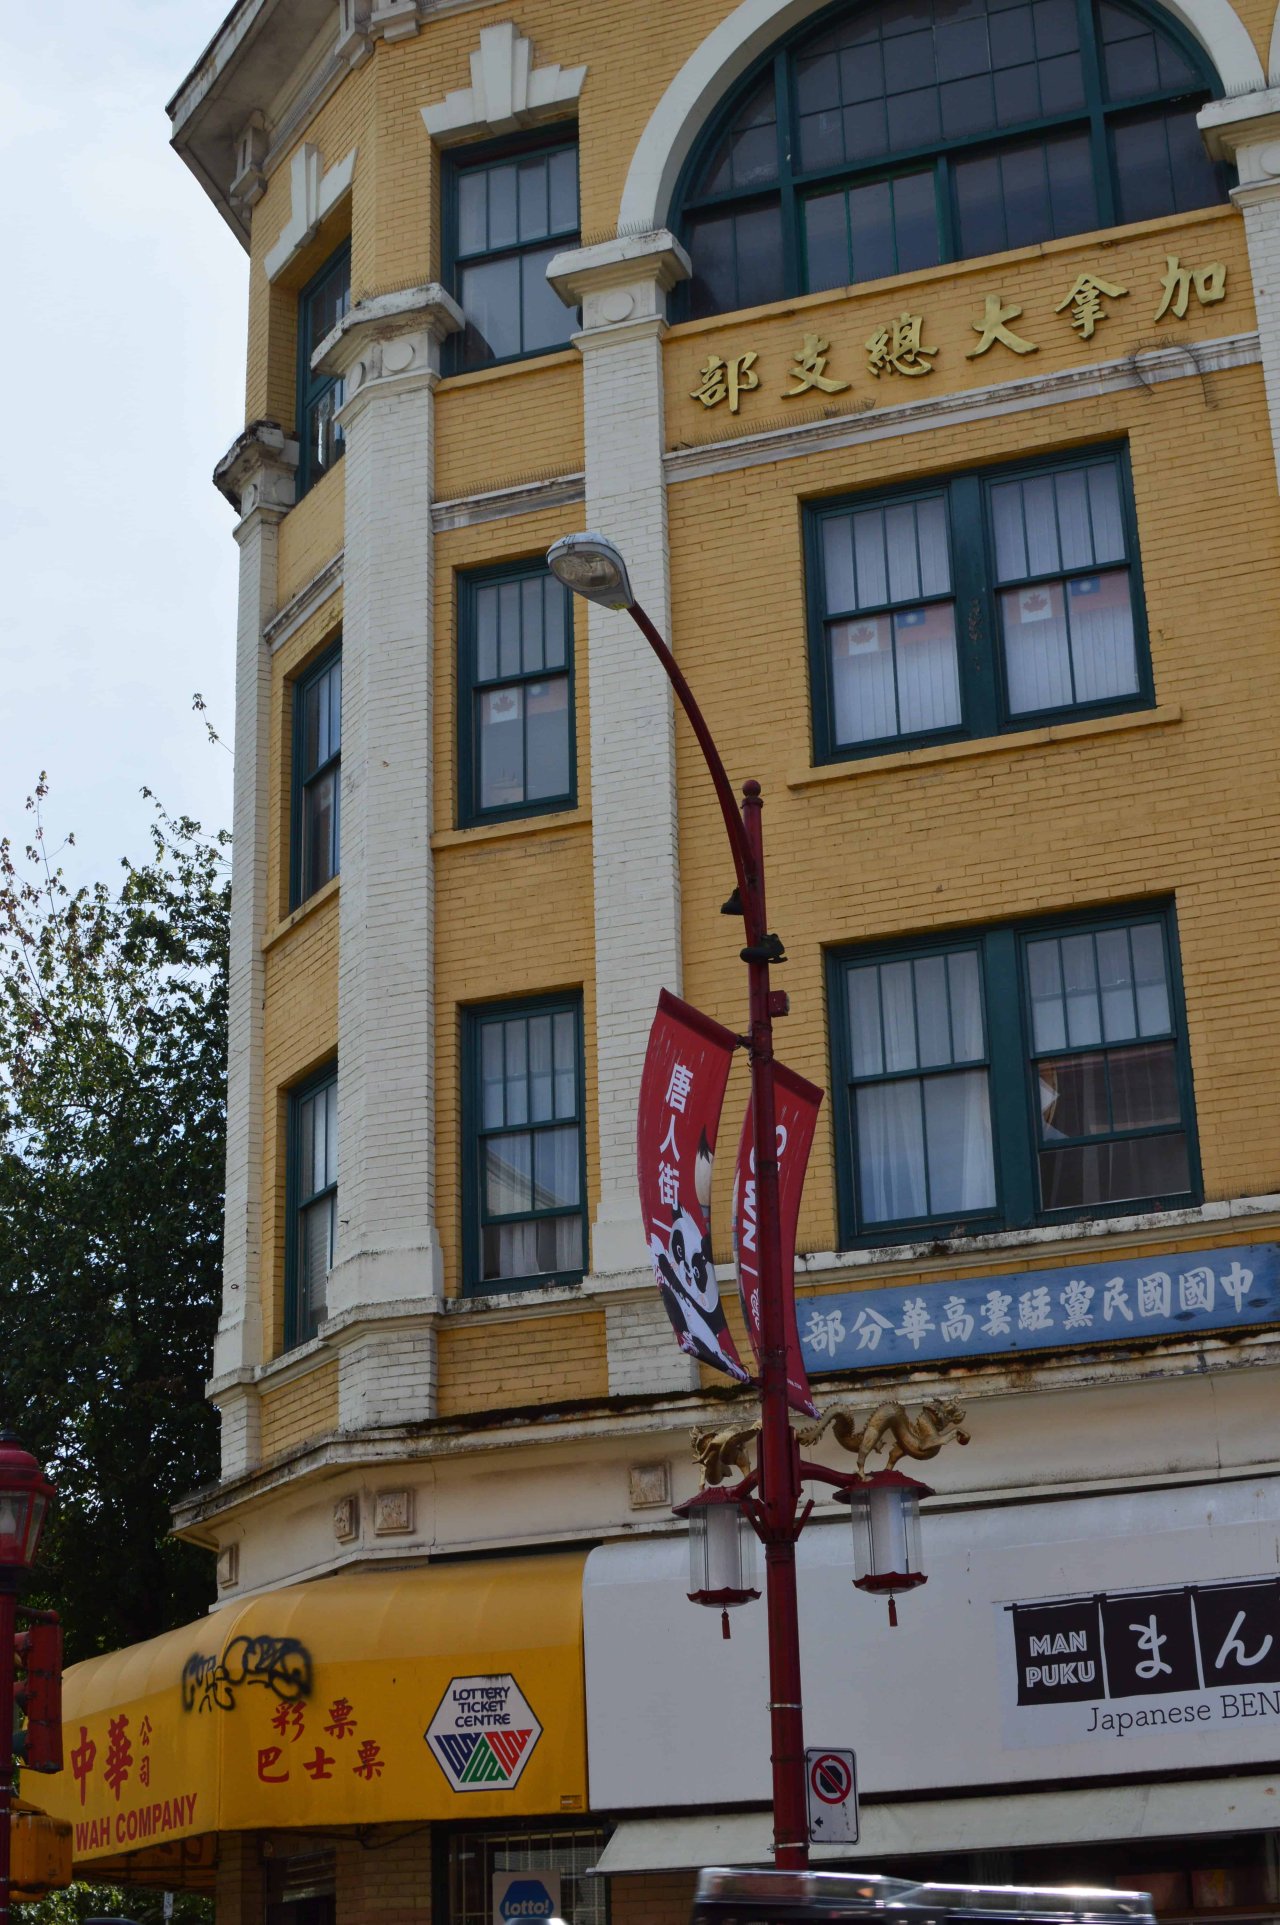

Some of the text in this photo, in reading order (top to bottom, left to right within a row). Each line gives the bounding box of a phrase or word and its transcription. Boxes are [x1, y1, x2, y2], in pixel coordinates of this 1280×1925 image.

[659, 1062, 694, 1211] 唐人街
[1029, 1630, 1088, 1657] MAN
[1025, 1660, 1096, 1688] PUKU
[452, 1686, 511, 1702] LOTTERY
[458, 1700, 506, 1714] TICKET
[271, 1698, 358, 1744] 彩票
[455, 1713, 511, 1728] CENTRE
[1087, 1704, 1211, 1737] Japanese
[257, 1740, 385, 1784] 巴士票
[76, 1793, 198, 1852] WAH COMPANY
